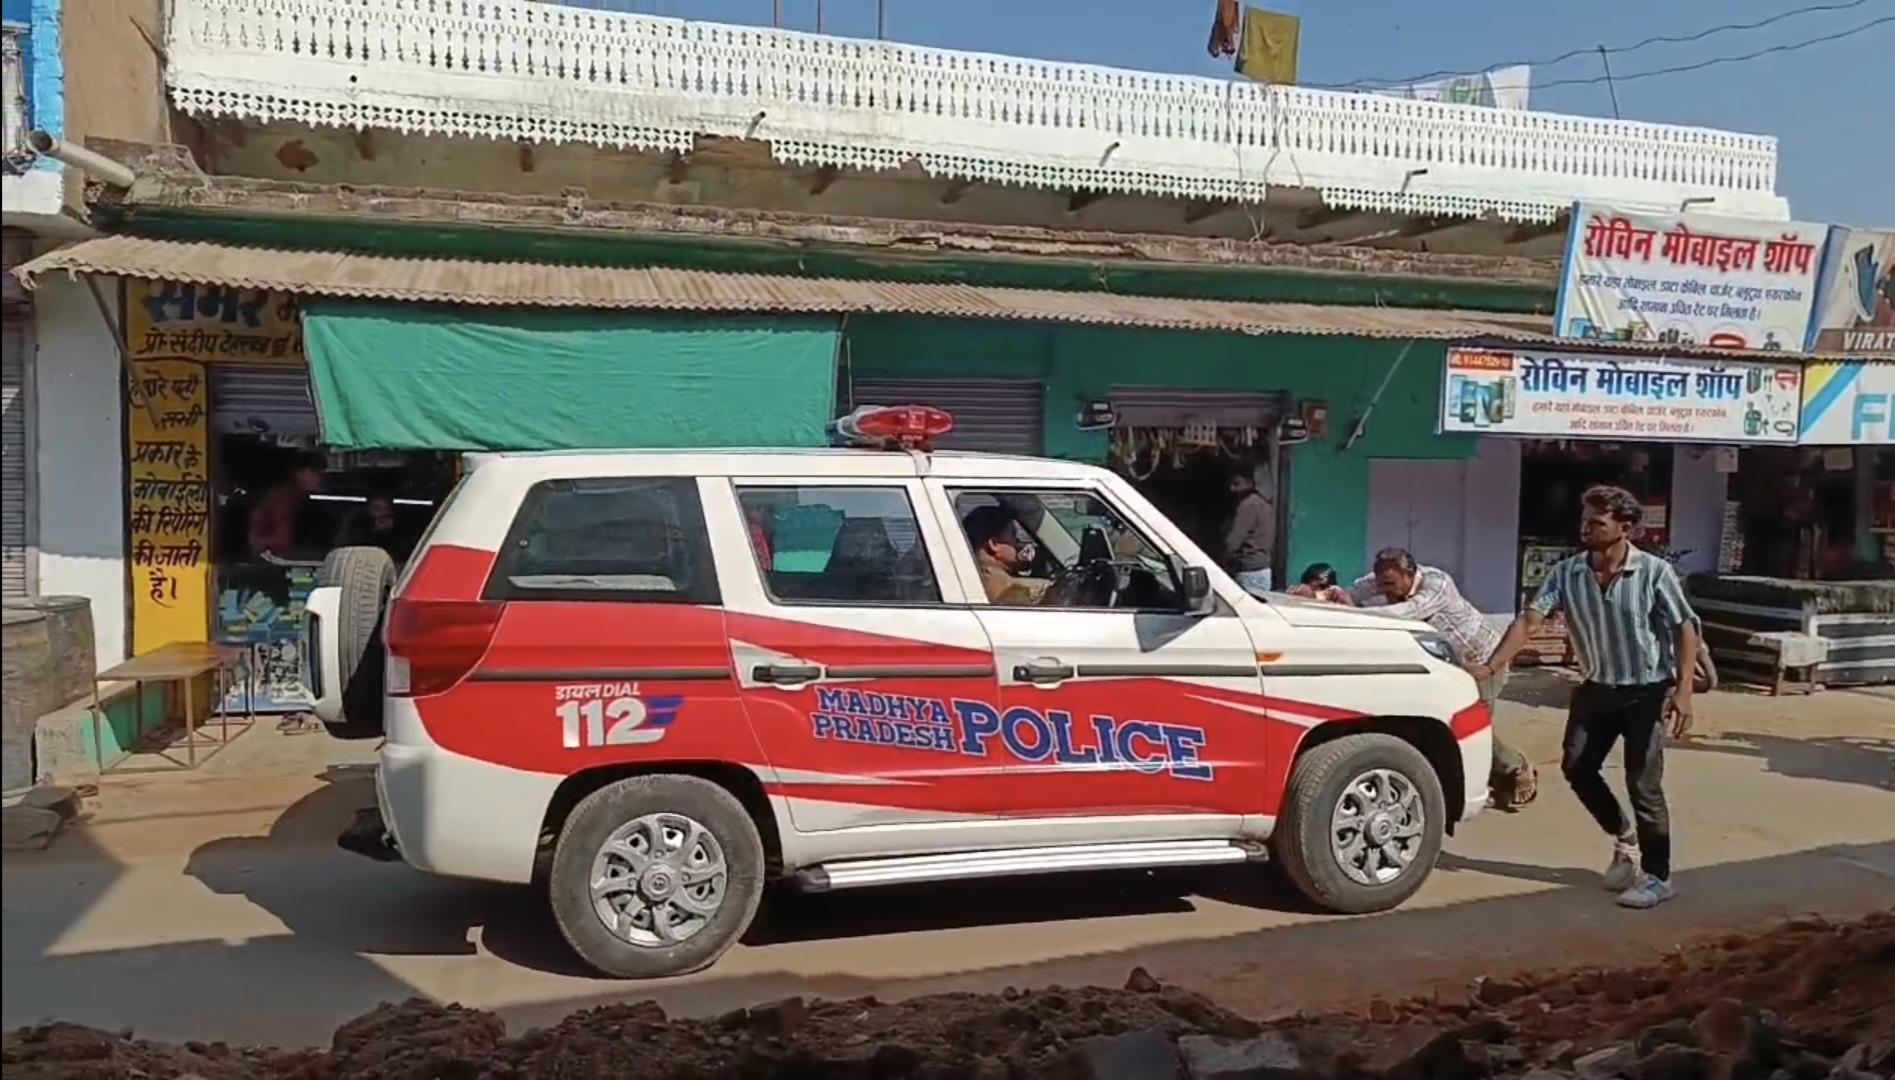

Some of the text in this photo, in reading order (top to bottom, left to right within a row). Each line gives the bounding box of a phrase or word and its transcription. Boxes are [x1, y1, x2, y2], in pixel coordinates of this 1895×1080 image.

[1584, 213, 1815, 274] रोविन मोबाइल शॉप
[1520, 356, 1744, 400] रोविन मोबाइल शॉप
[131, 440, 202, 470] प्रकार के
[132, 503, 156, 534] की
[134, 538, 202, 568] की जाती
[555, 682, 641, 700] डायल DIAL
[815, 686, 951, 725] MADHYA
[555, 697, 665, 748] 112
[811, 712, 957, 752] PRADESH
[952, 698, 1214, 781] POLICE
